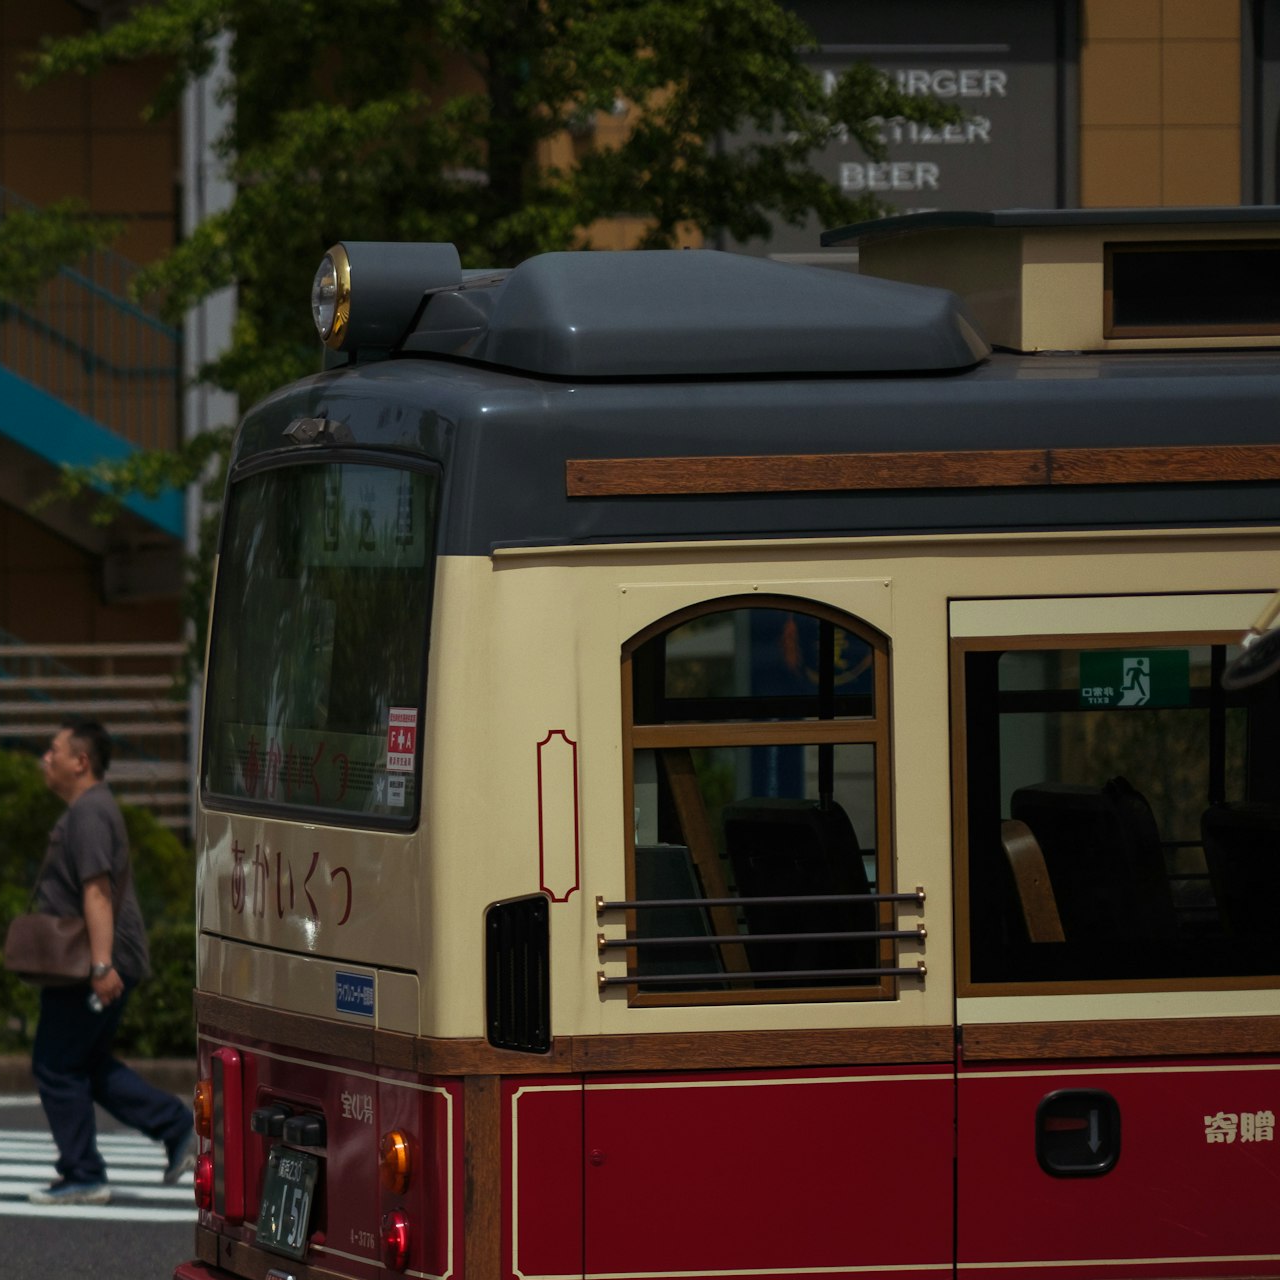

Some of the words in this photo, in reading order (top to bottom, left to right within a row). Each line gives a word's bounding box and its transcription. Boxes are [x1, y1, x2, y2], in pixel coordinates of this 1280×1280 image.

[839, 161, 940, 191] BEER
[231, 840, 353, 927] あかいくつ
[1204, 1110, 1275, 1144] 寄贈
